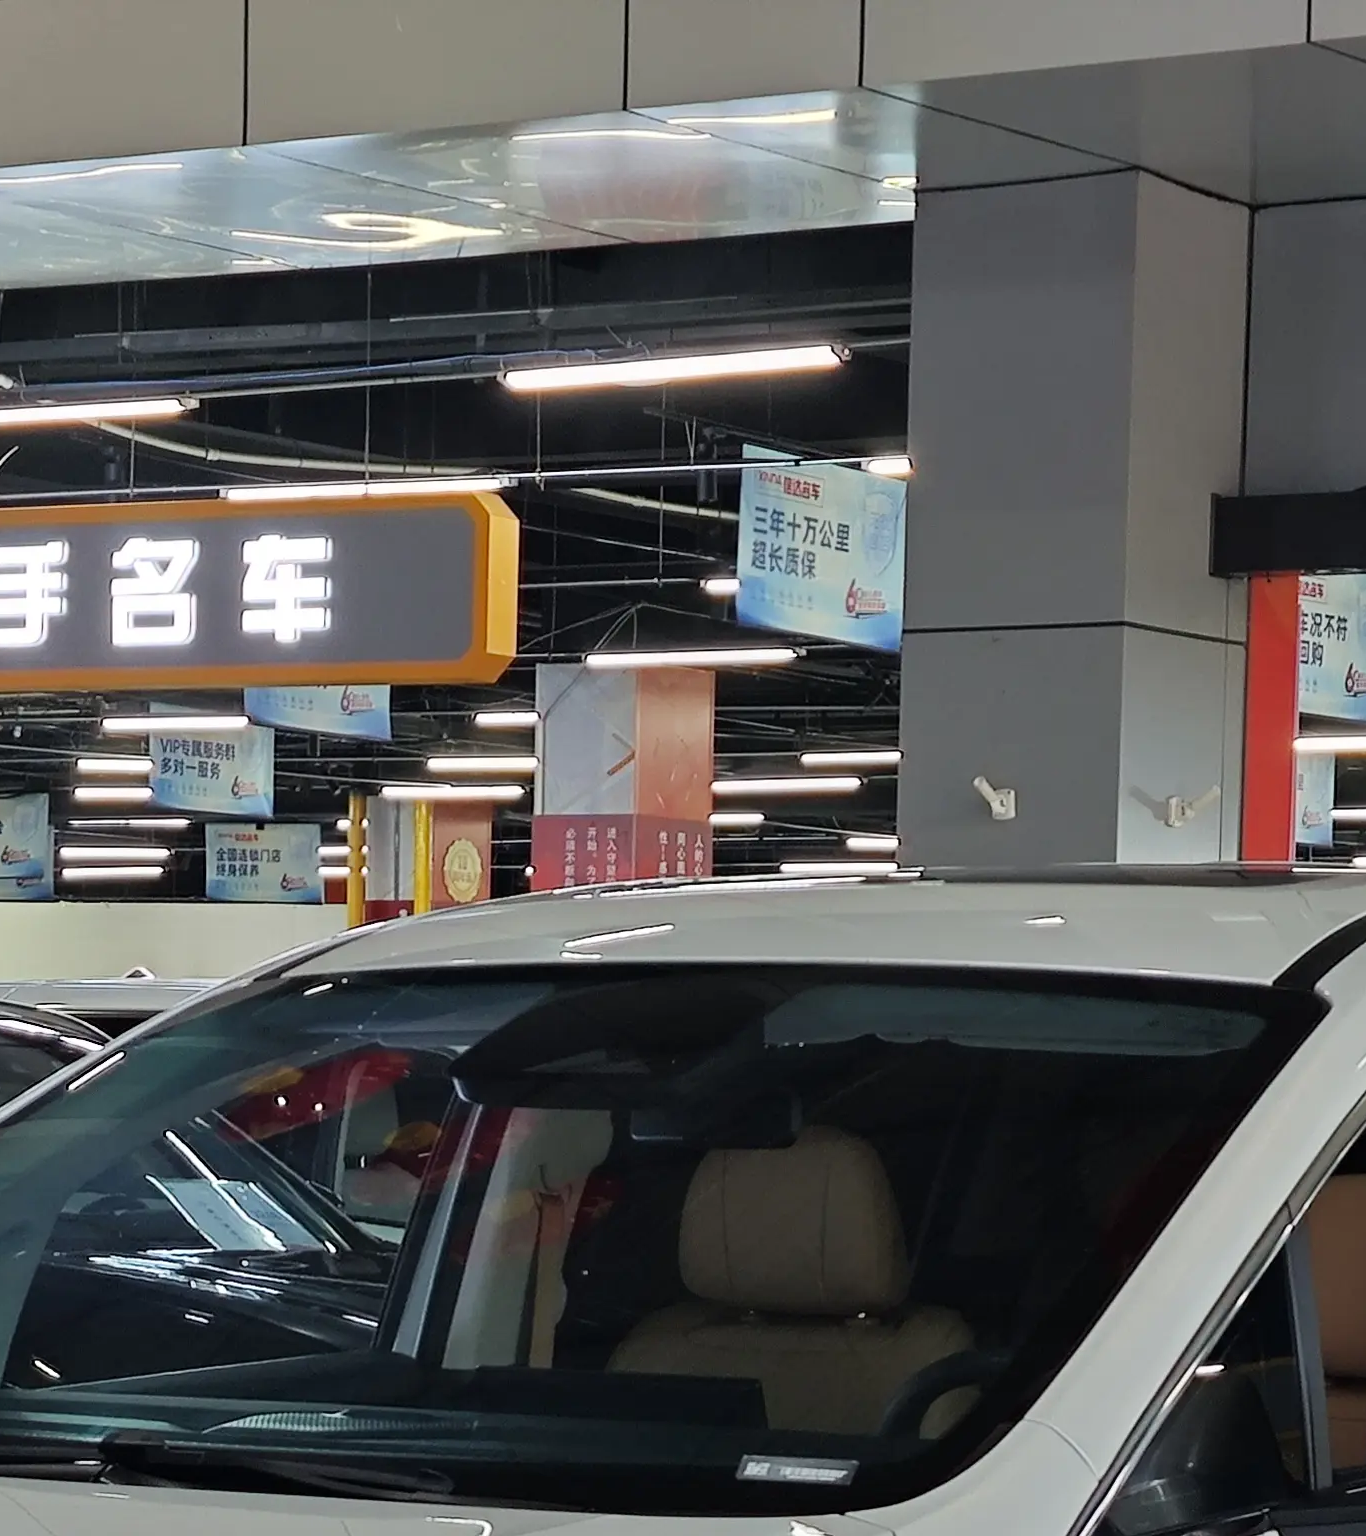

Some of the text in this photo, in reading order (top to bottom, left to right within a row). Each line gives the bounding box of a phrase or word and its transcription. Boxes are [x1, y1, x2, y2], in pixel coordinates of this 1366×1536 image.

[752, 506, 851, 553] 三年十万公里
[751, 540, 817, 580] 超长质保
[1300, 640, 1325, 668] 回购
[160, 757, 222, 781] 多对一服务
[215, 847, 282, 864] 全国连锁门店
[215, 862, 260, 879] 终身保养
